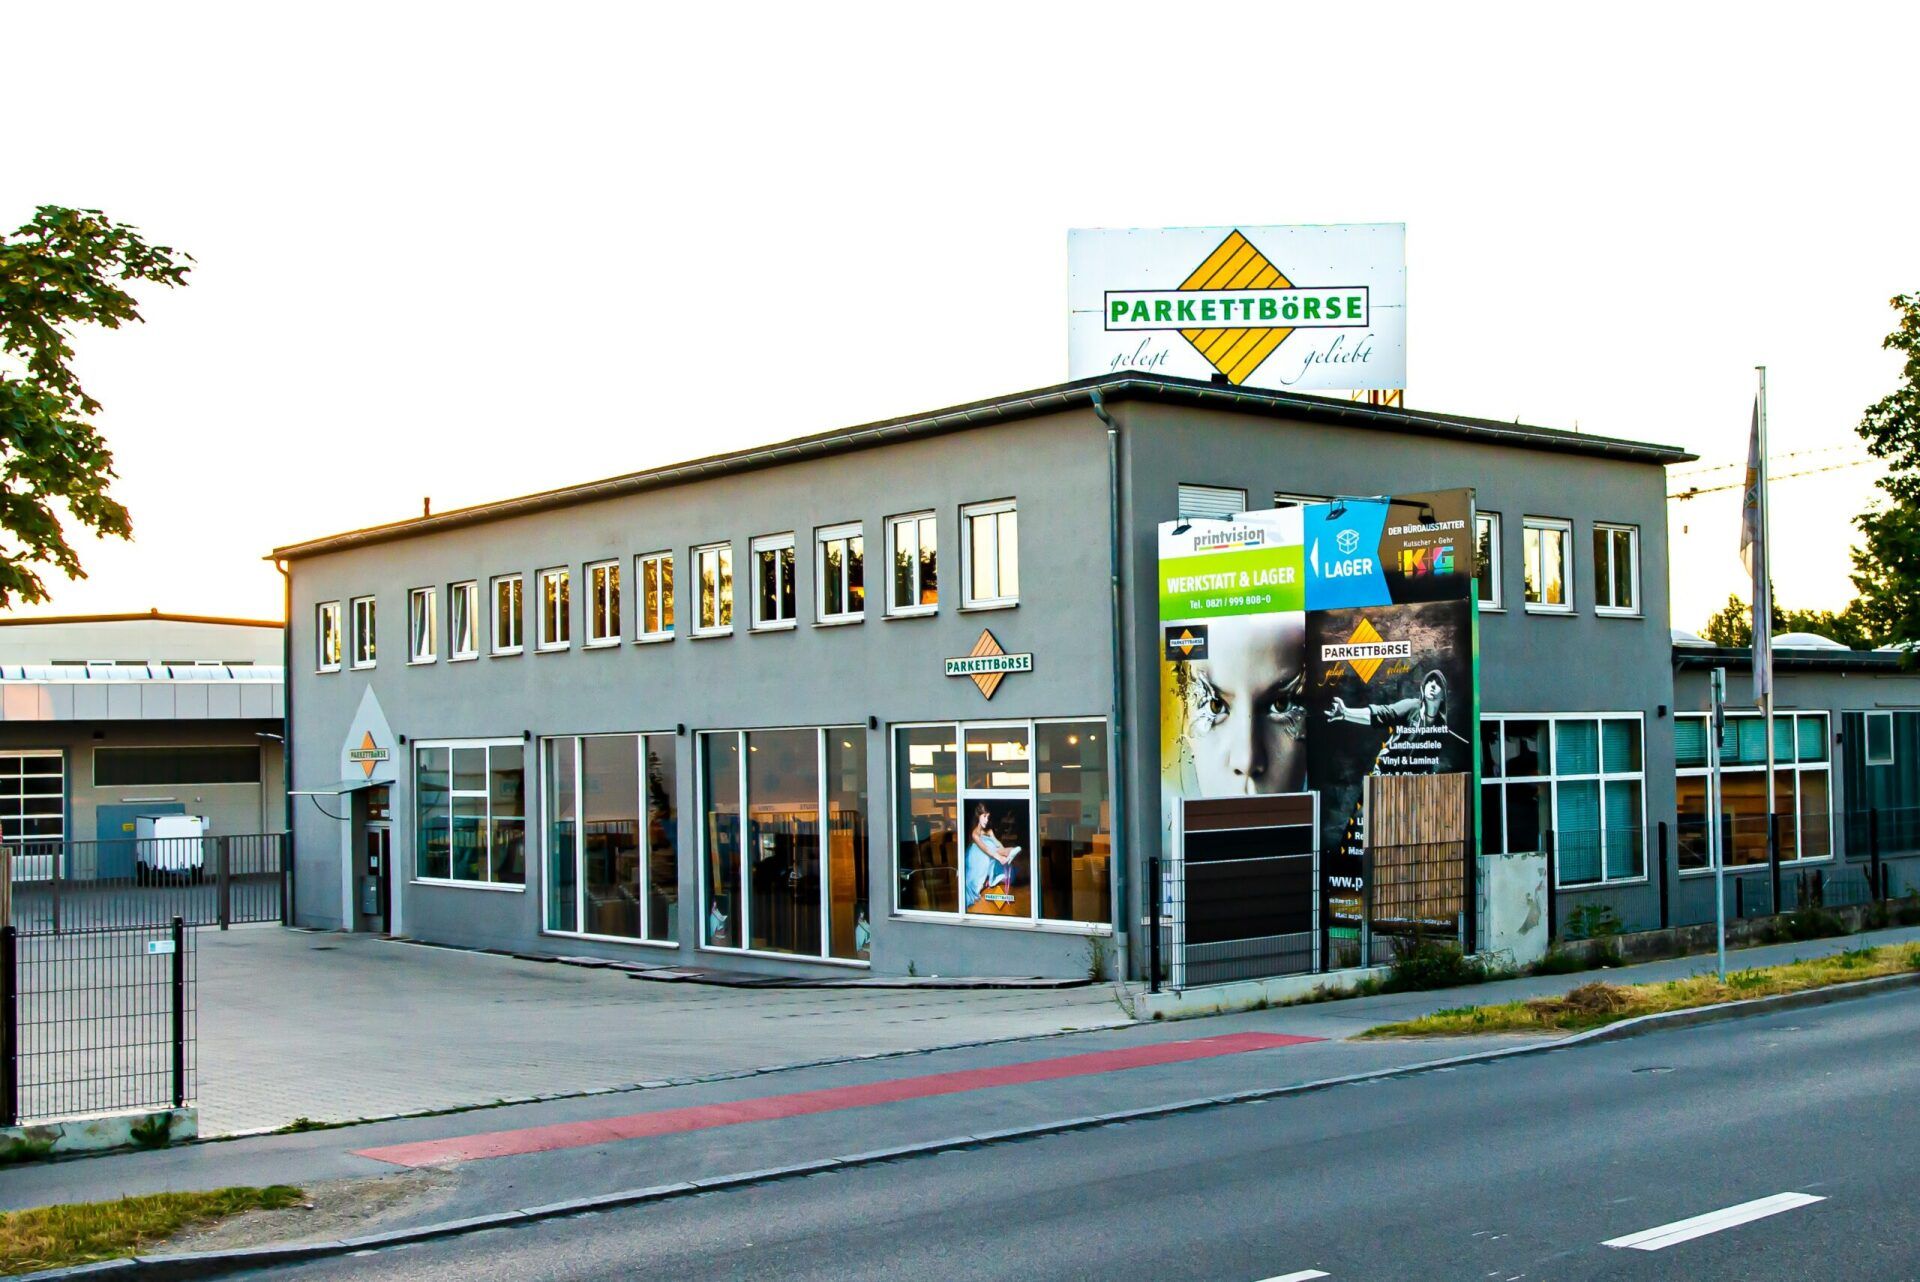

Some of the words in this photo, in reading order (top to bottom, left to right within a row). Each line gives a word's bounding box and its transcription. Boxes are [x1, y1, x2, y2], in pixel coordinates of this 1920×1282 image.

[1110, 337, 1170, 370] gelegt
[1281, 333, 1375, 385] geliebt
[1388, 526, 1402, 536] DER
[1403, 520, 1465, 534] BÜROAUSSTATTER
[1193, 525, 1265, 551] printvision
[1403, 539, 1431, 547] Kutscher
[1438, 537, 1454, 545] Gehr
[1324, 558, 1372, 579] LAGER
[1167, 572, 1236, 594] WERKSTATT
[1239, 571, 1250, 587] &
[1253, 567, 1295, 586] LAGER
[1190, 600, 1203, 609] Tel.
[1206, 598, 1222, 608] 0821
[1229, 597, 1244, 606] 999
[1246, 595, 1271, 605] 808-0
[1396, 725, 1448, 735] Massivparkett
[1389, 740, 1442, 750] Landhausdiele
[1382, 756, 1400, 766] Vinyl
[1401, 756, 1408, 765] &
[1409, 755, 1440, 765] Laminat
